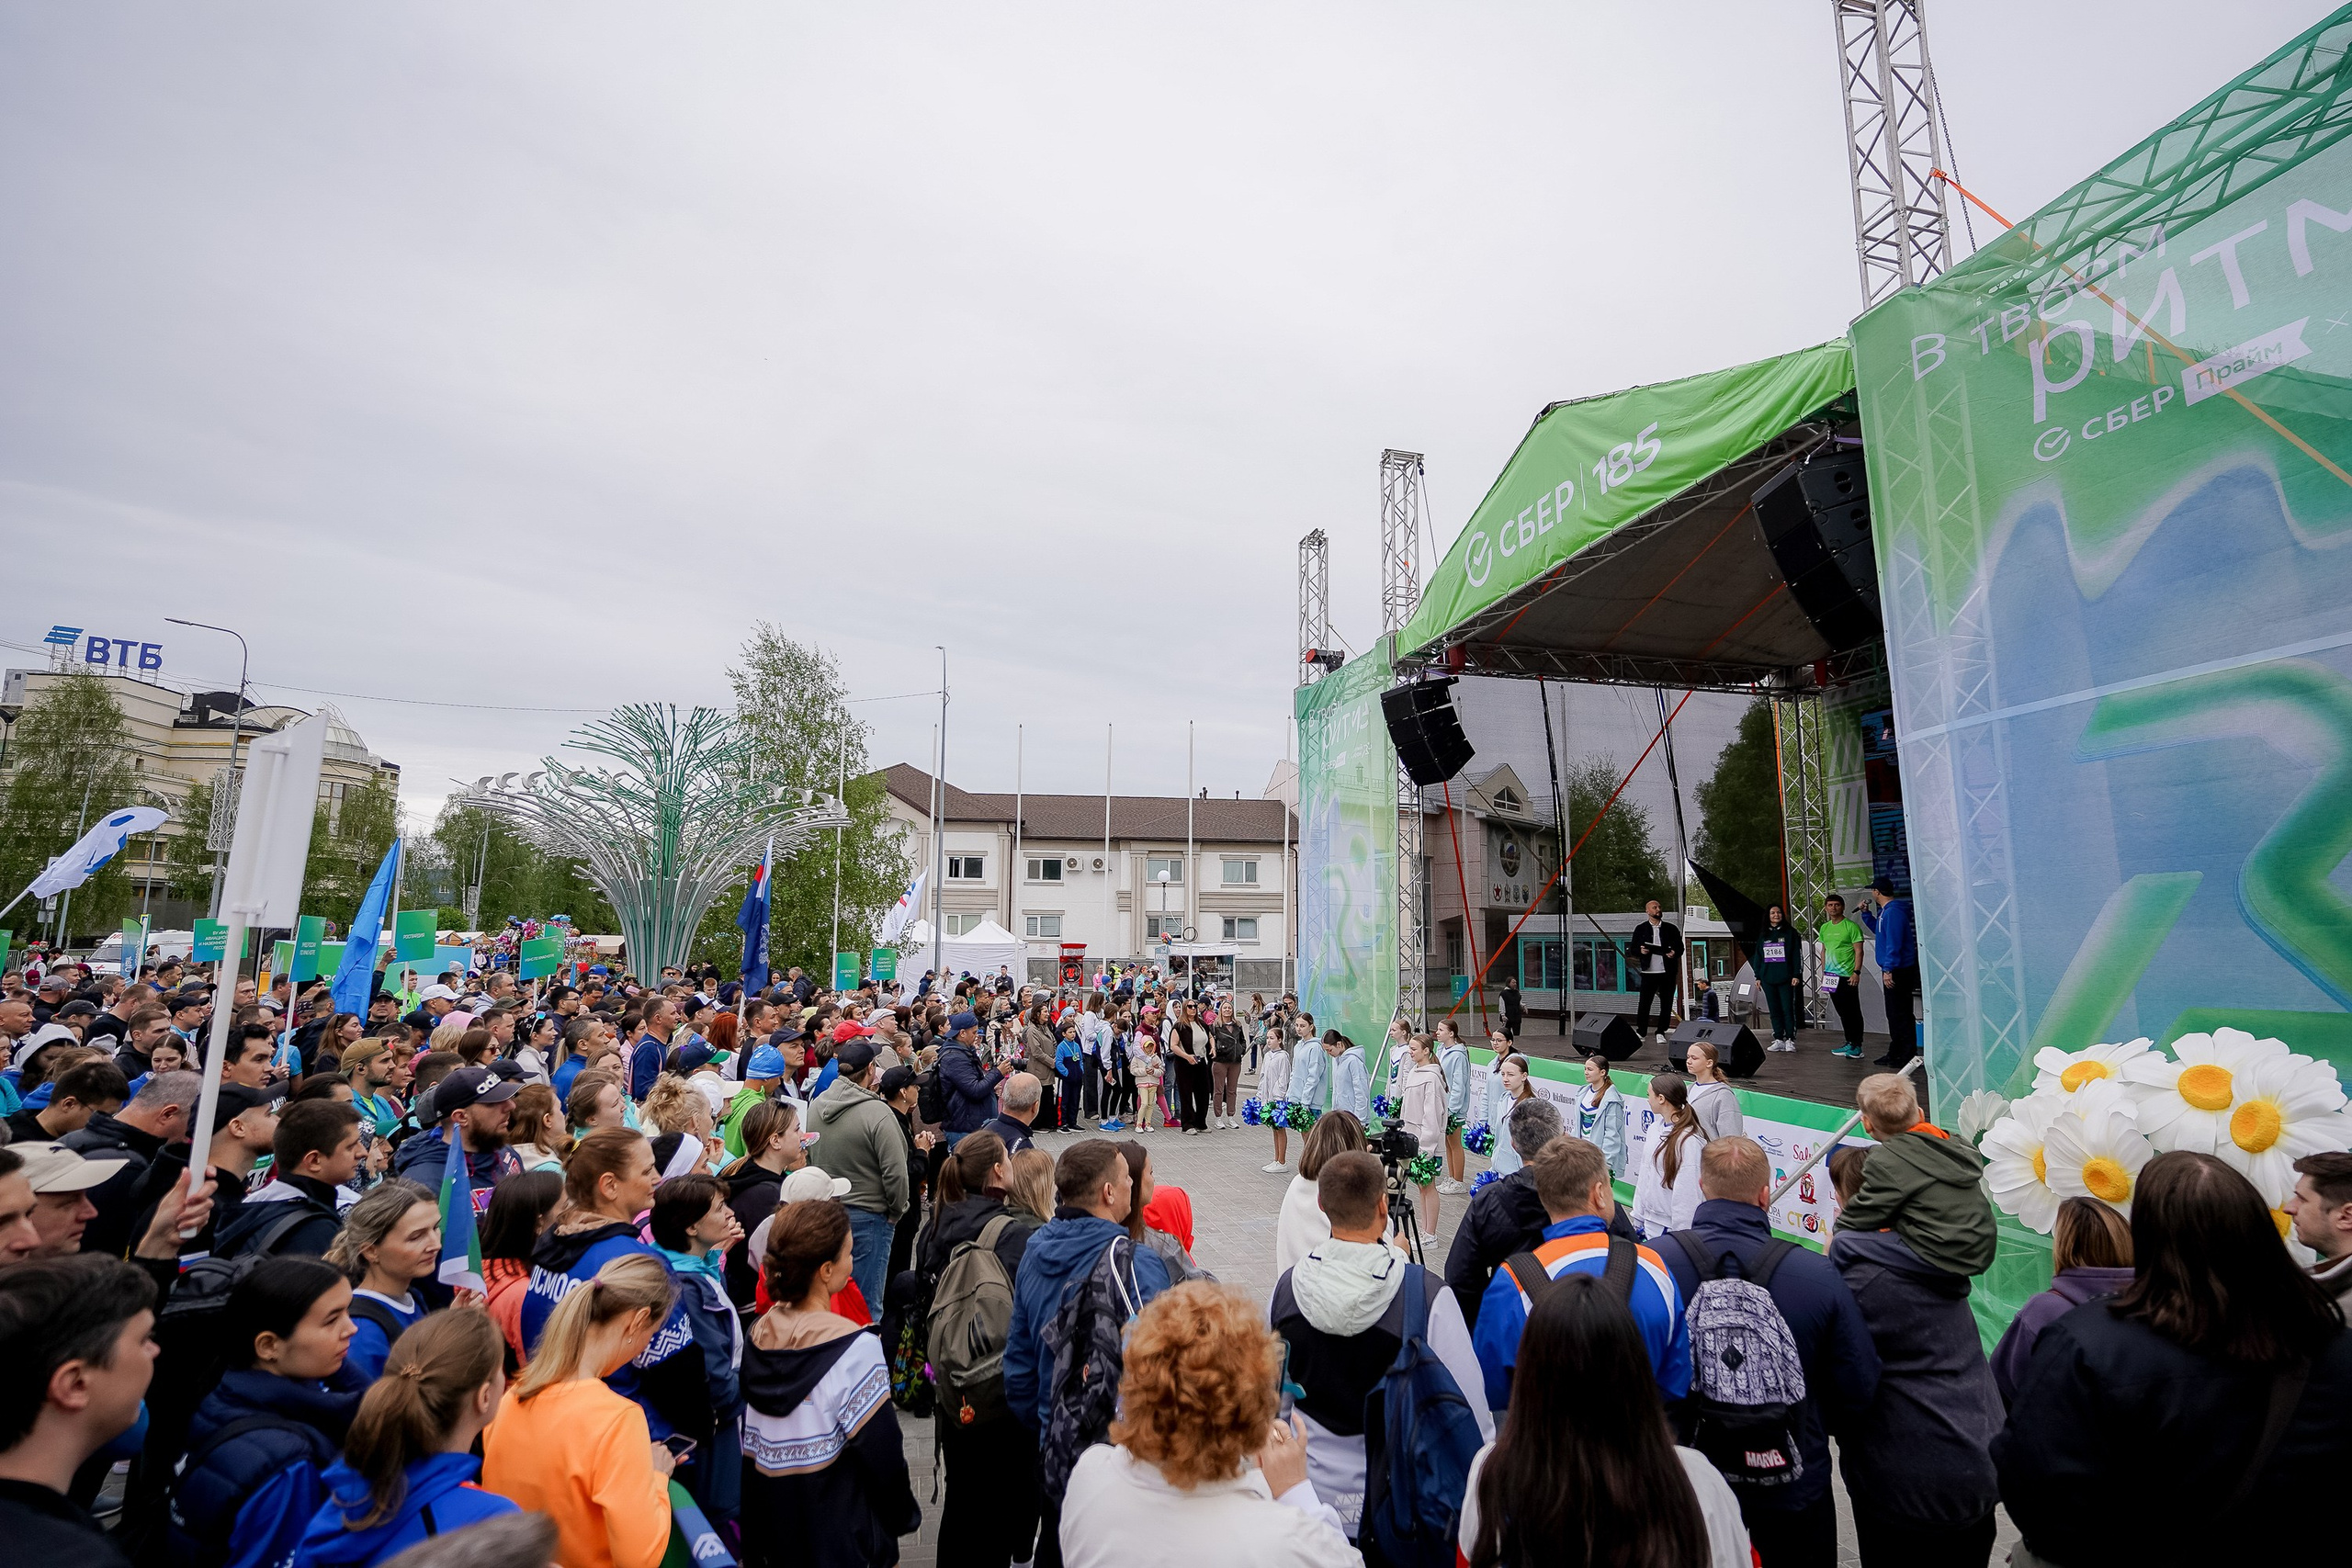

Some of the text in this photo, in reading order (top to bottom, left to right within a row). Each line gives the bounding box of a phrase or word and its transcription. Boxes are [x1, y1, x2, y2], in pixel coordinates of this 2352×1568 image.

[1910, 333, 1946, 381] В
[2081, 341, 2284, 440] СБЕР Прайм
[1498, 421, 1662, 558] СБЕР 185
[85, 636, 164, 670] ВТБ
[1826, 977, 1838, 986] 2185
[476, 1072, 502, 1094] adi
[1745, 1449, 1786, 1469] MARVEL
